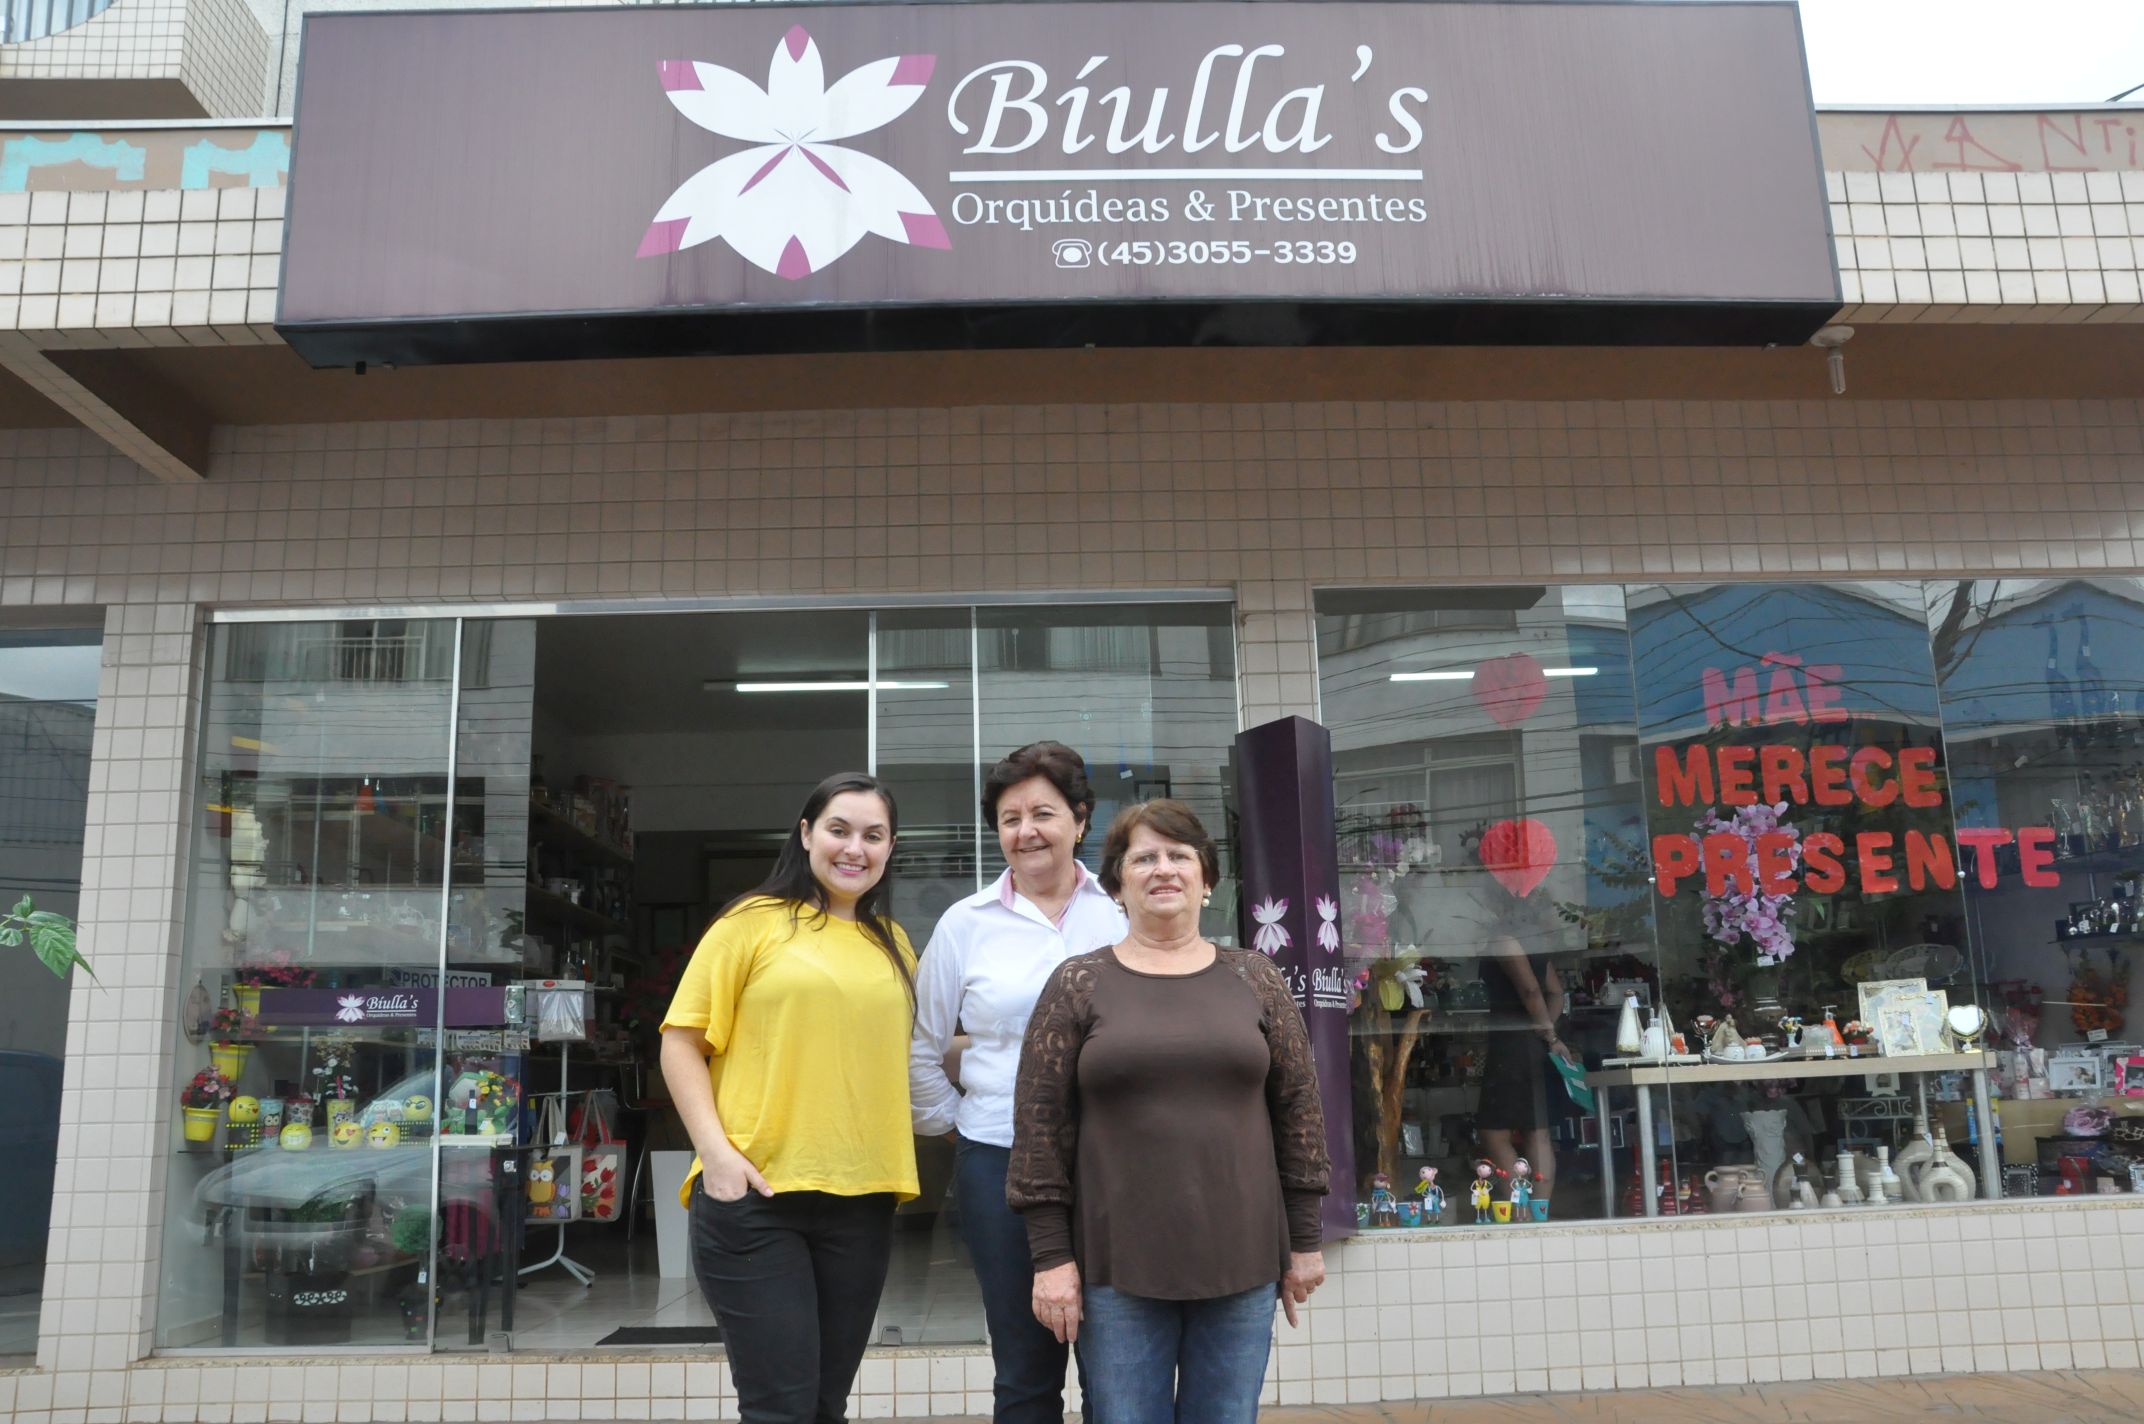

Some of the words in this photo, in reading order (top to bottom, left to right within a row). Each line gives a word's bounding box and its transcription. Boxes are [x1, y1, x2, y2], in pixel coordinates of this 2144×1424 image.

[952, 189, 1170, 231] Orquídeas
[1184, 189, 1217, 222] &
[1226, 190, 1427, 222] Presentes
[1097, 240, 1357, 266] (45)3055-3339
[1655, 744, 1943, 808] MERECE
[1652, 827, 2061, 897] PRESENTE
